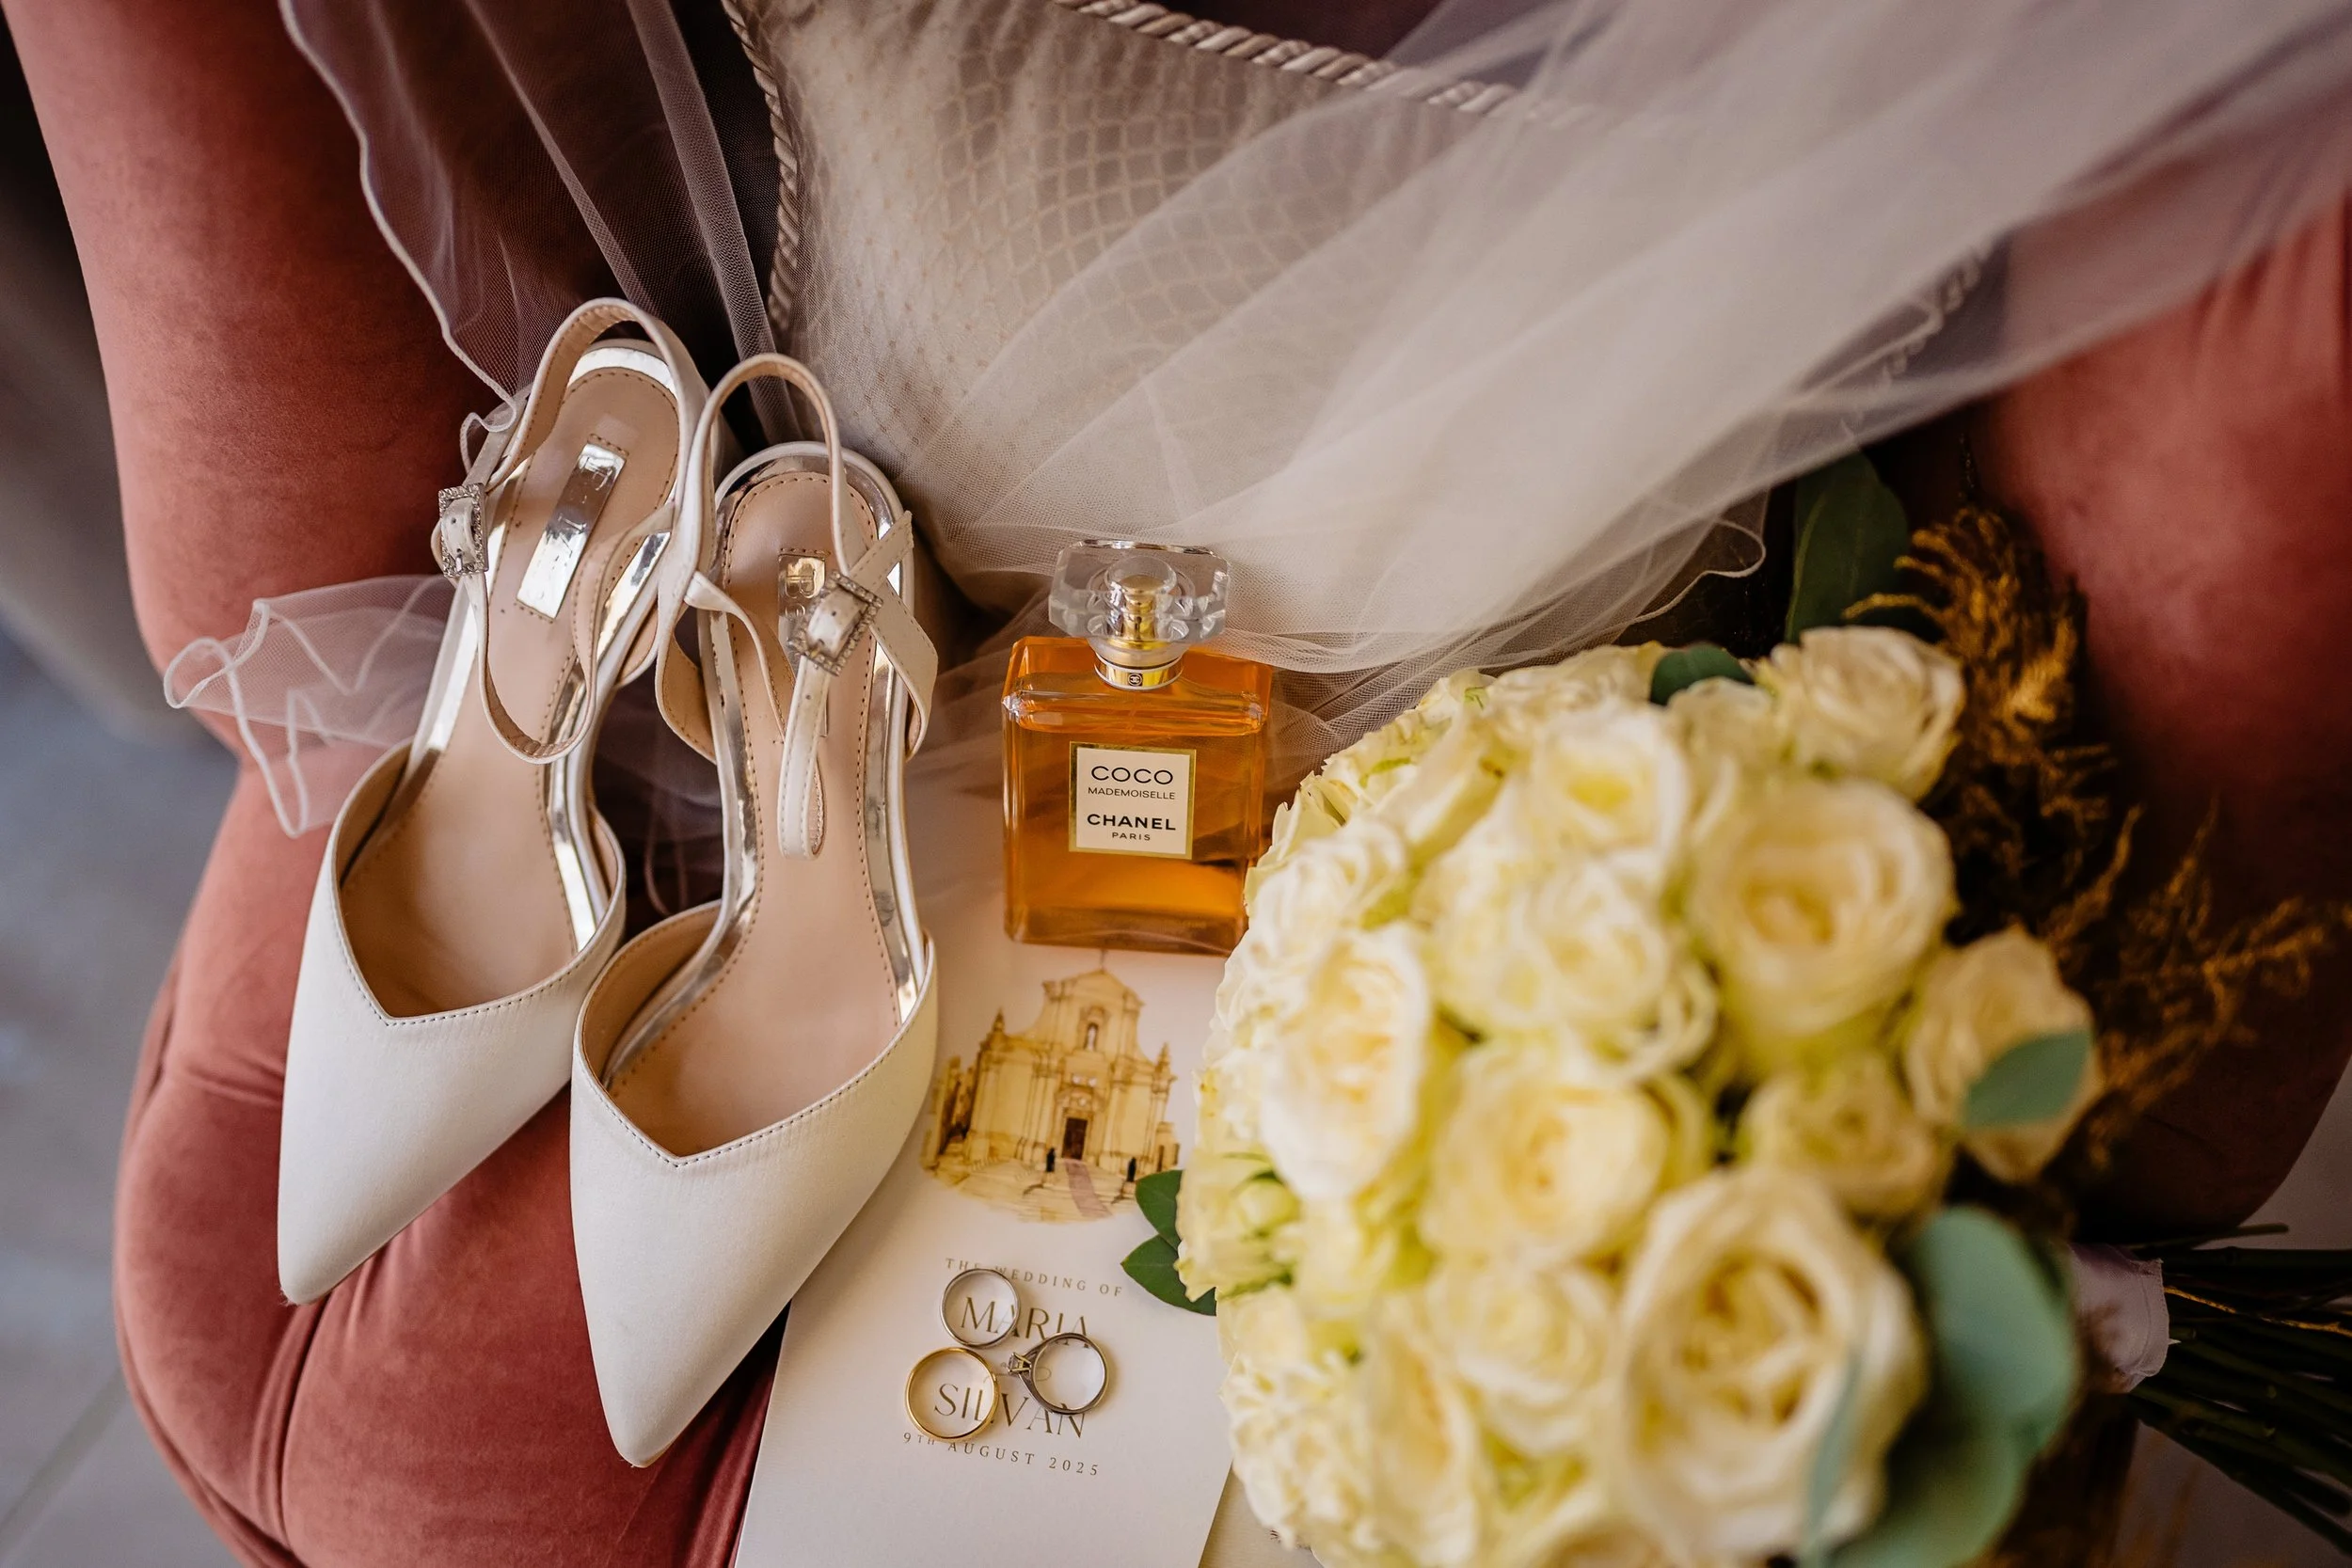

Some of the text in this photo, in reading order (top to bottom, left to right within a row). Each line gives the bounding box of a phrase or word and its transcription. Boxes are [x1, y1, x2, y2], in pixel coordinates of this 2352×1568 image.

[1090, 765, 1174, 785] COCO
[1088, 786, 1176, 800] MADEMOISELLE
[1087, 813, 1176, 831] CHANEL
[1111, 832, 1151, 841] PARIS
[1099, 1283, 1122, 1297] OF
[960, 1296, 1090, 1349] MARIA
[934, 1383, 1086, 1438] SILVAN
[947, 1440, 1035, 1465] AUGUST
[1048, 1457, 1099, 1476] 2025
